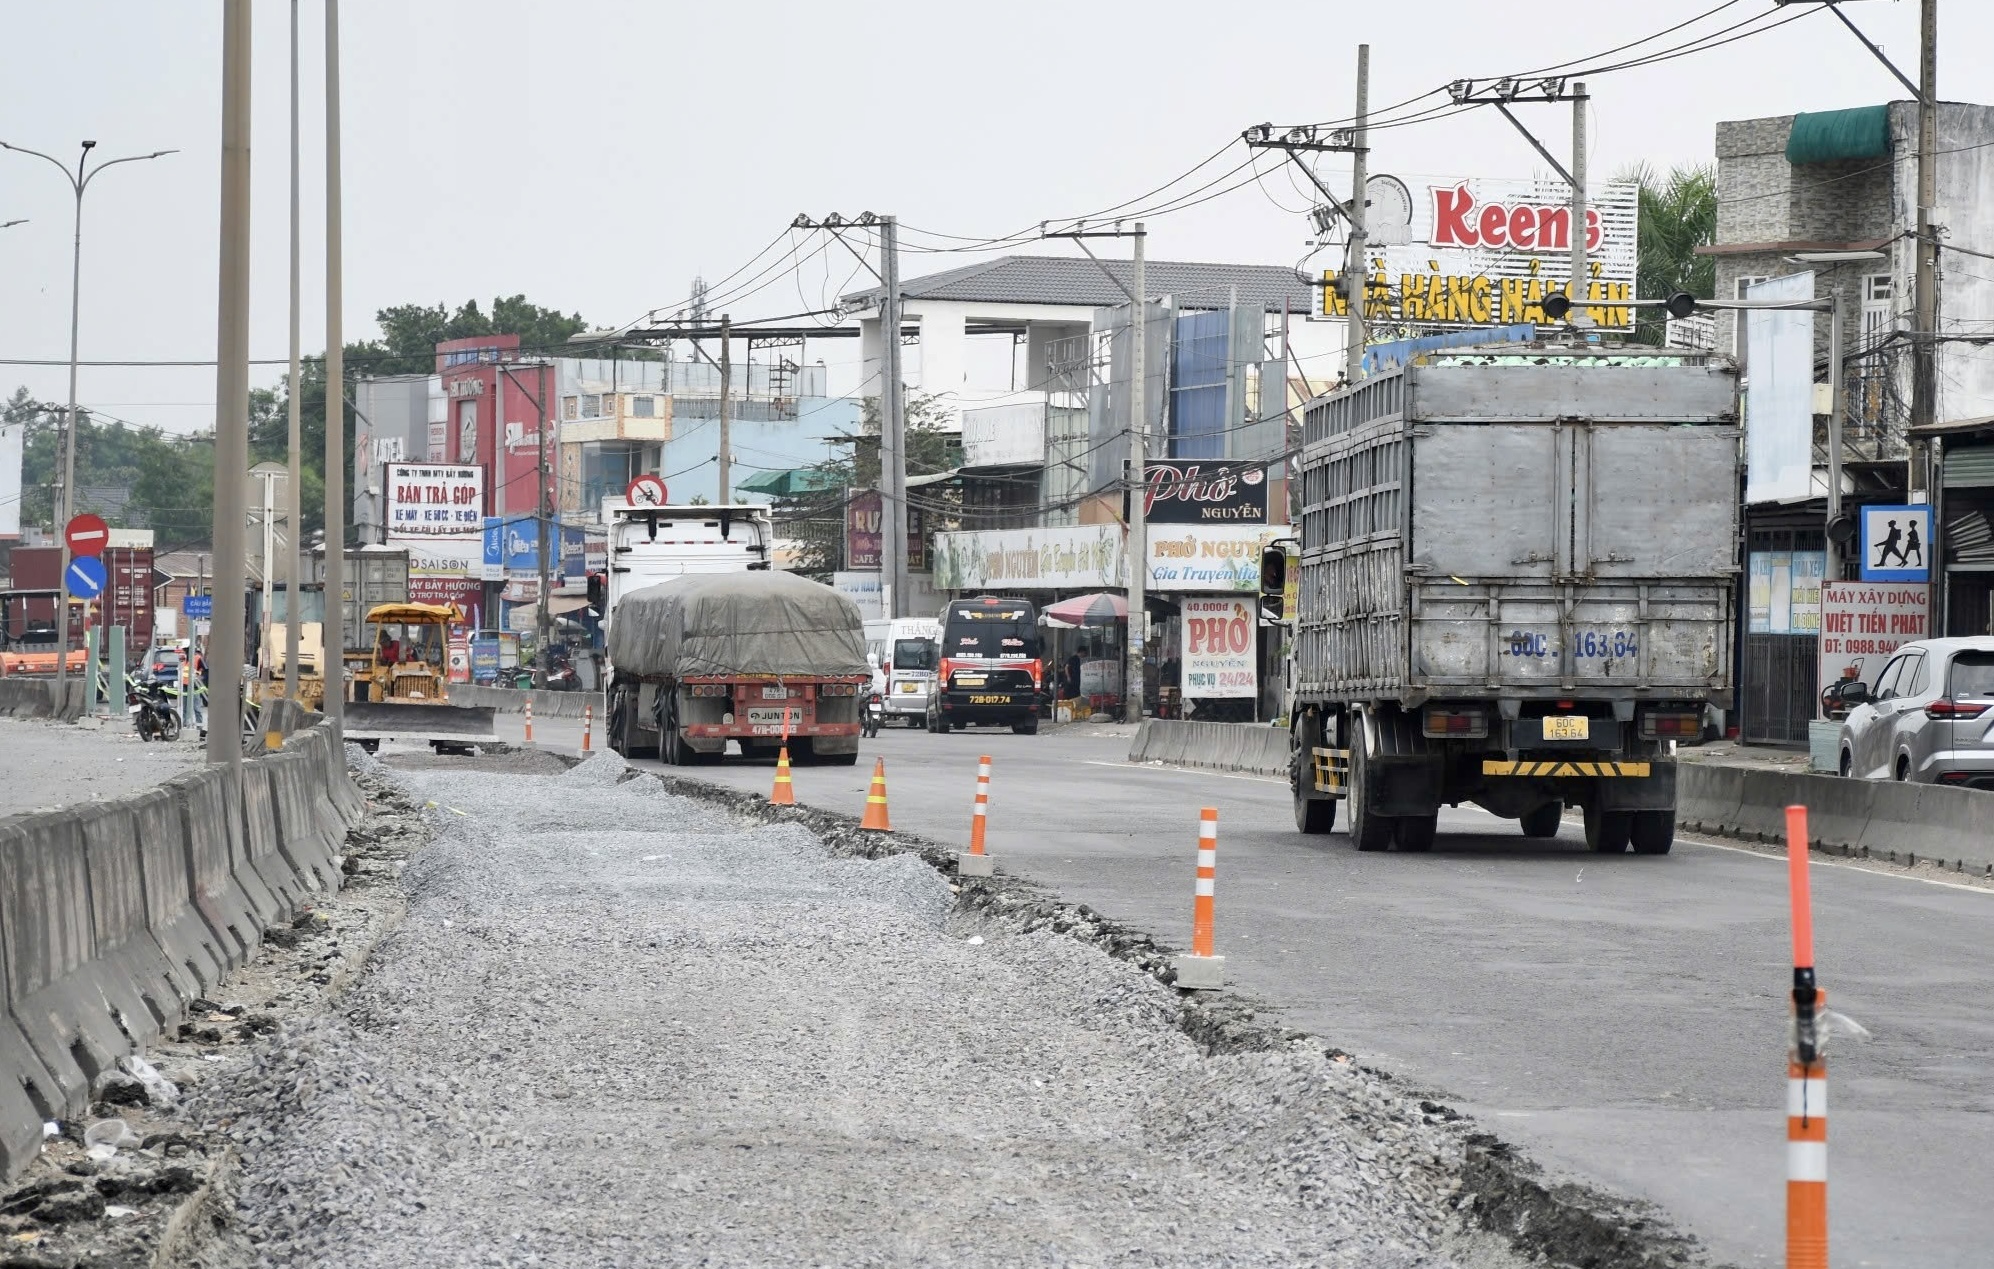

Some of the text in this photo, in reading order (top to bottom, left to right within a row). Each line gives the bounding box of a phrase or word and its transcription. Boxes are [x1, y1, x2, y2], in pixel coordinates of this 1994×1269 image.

[1324, 258, 1392, 318] NÀ
[1401, 260, 1492, 323] HÀNG
[411, 469, 417, 478] TY
[397, 481, 476, 505] BÁN TRẢ GÓP
[1144, 465, 1238, 517] Phở
[396, 509, 403, 520] XE
[405, 509, 417, 520] MÁY
[424, 510, 432, 521] XE
[455, 511, 462, 521] XE
[1201, 503, 1262, 518] NGUYỄN
[1154, 535, 1197, 558] PHỞ
[1153, 567, 1178, 580] Gia
[445, 581, 481, 591] HƯƠNG
[1826, 588, 1926, 607] MÁY XÂY DỰNG
[1187, 603, 1229, 612] 40.000đ
[1187, 603, 1251, 656] PHỞ
[1826, 608, 1925, 636] VIỆT TIẾN PHÁT
[1574, 631, 1638, 658] 163.64
[1825, 638, 1842, 653] ĐT:
[1192, 657, 1245, 668] NGUYỄN
[1188, 672, 1254, 689] PHỤC VỤ 24/24
[969, 695, 1011, 704] 72B-017.74
[1556, 718, 1575, 728] 60C
[1550, 729, 1583, 738] 163.64
